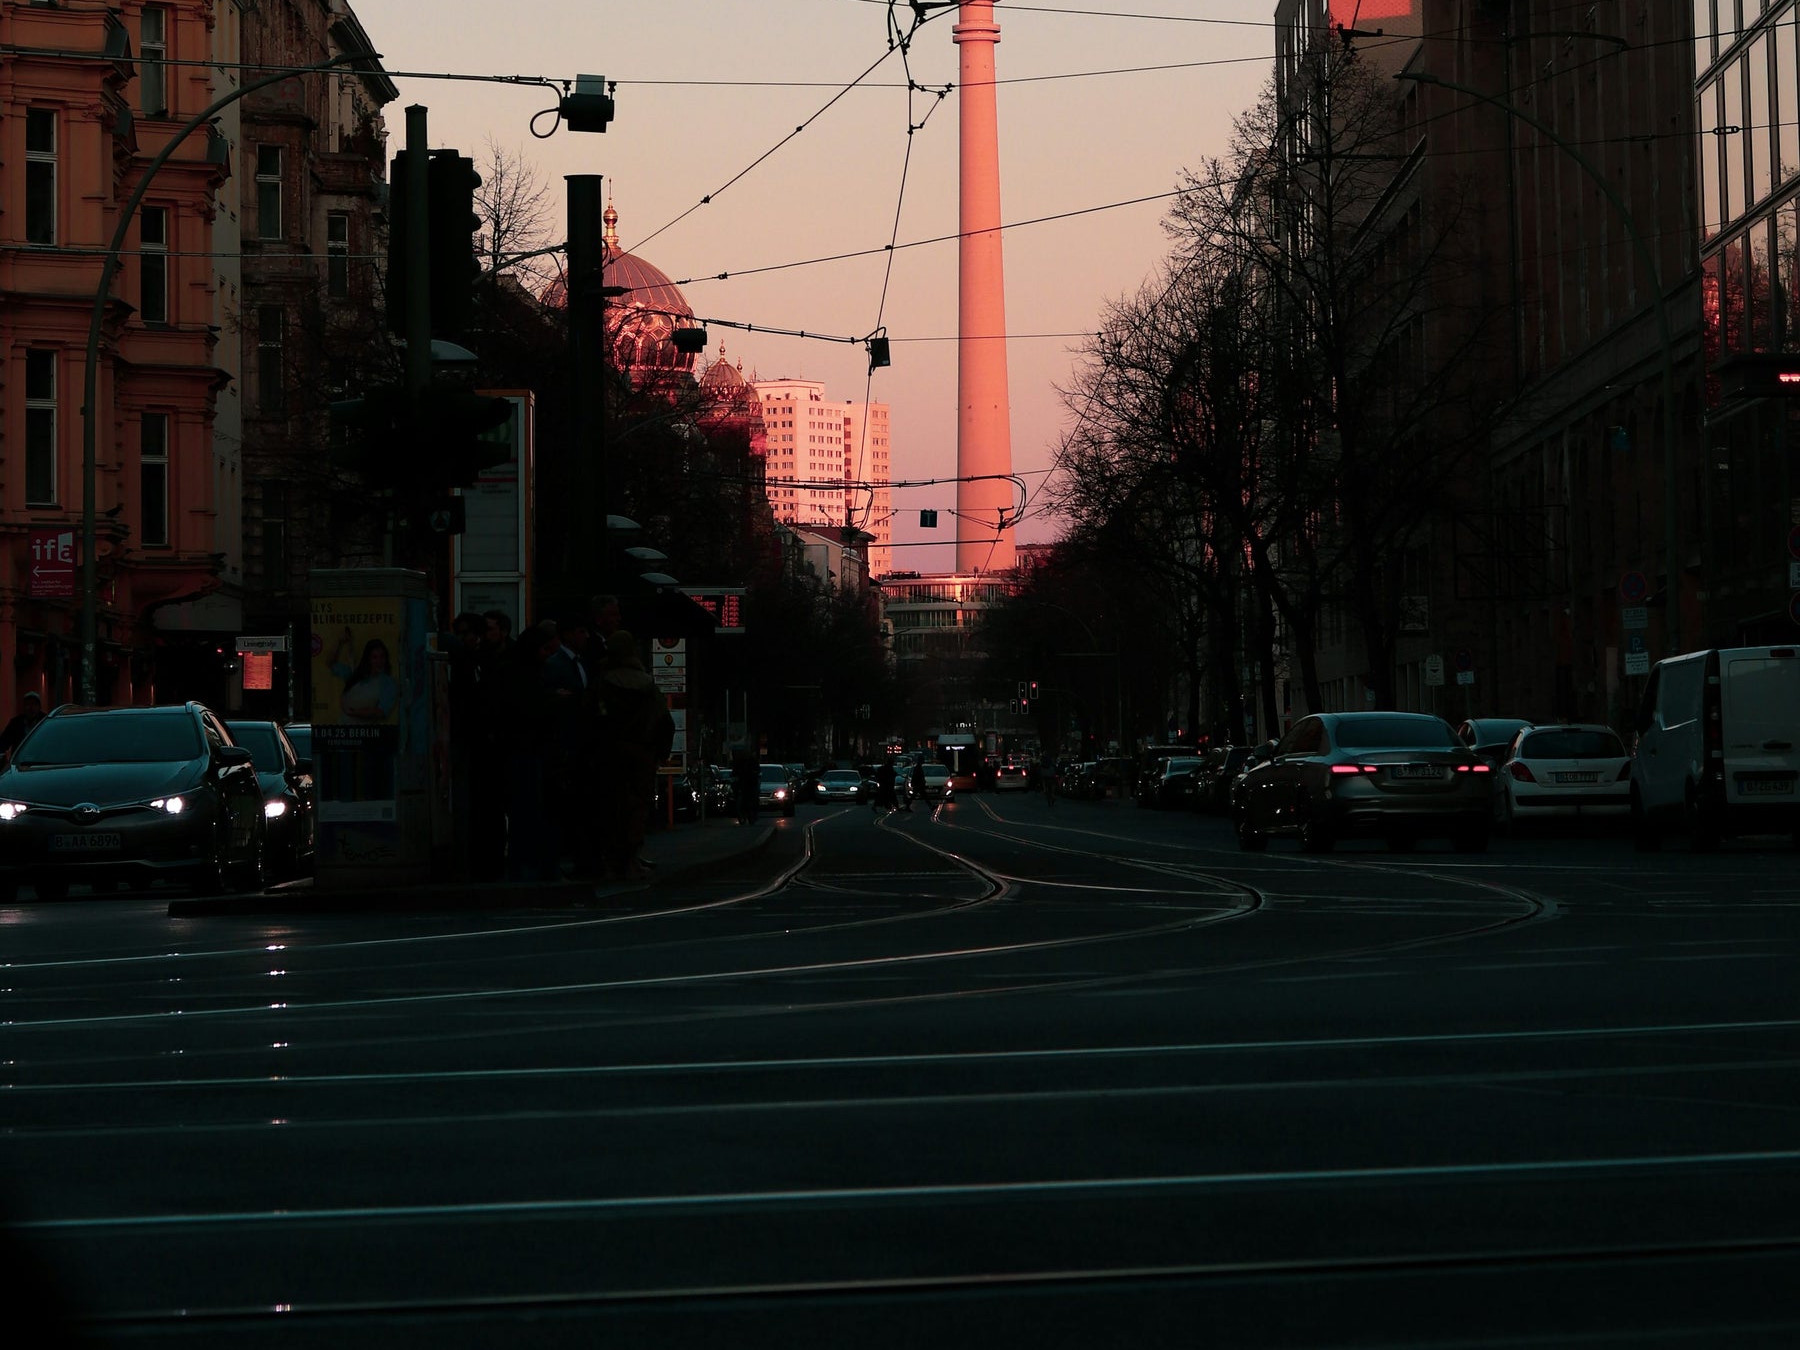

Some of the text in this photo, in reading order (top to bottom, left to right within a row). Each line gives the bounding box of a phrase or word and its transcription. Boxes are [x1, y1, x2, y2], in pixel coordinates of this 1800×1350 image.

[32, 533, 73, 562] ifa
[313, 613, 395, 624] BLINGSREZEPTE
[349, 728, 380, 738] BERLIN
[55, 836, 64, 848] B
[90, 835, 119, 847] 6896
